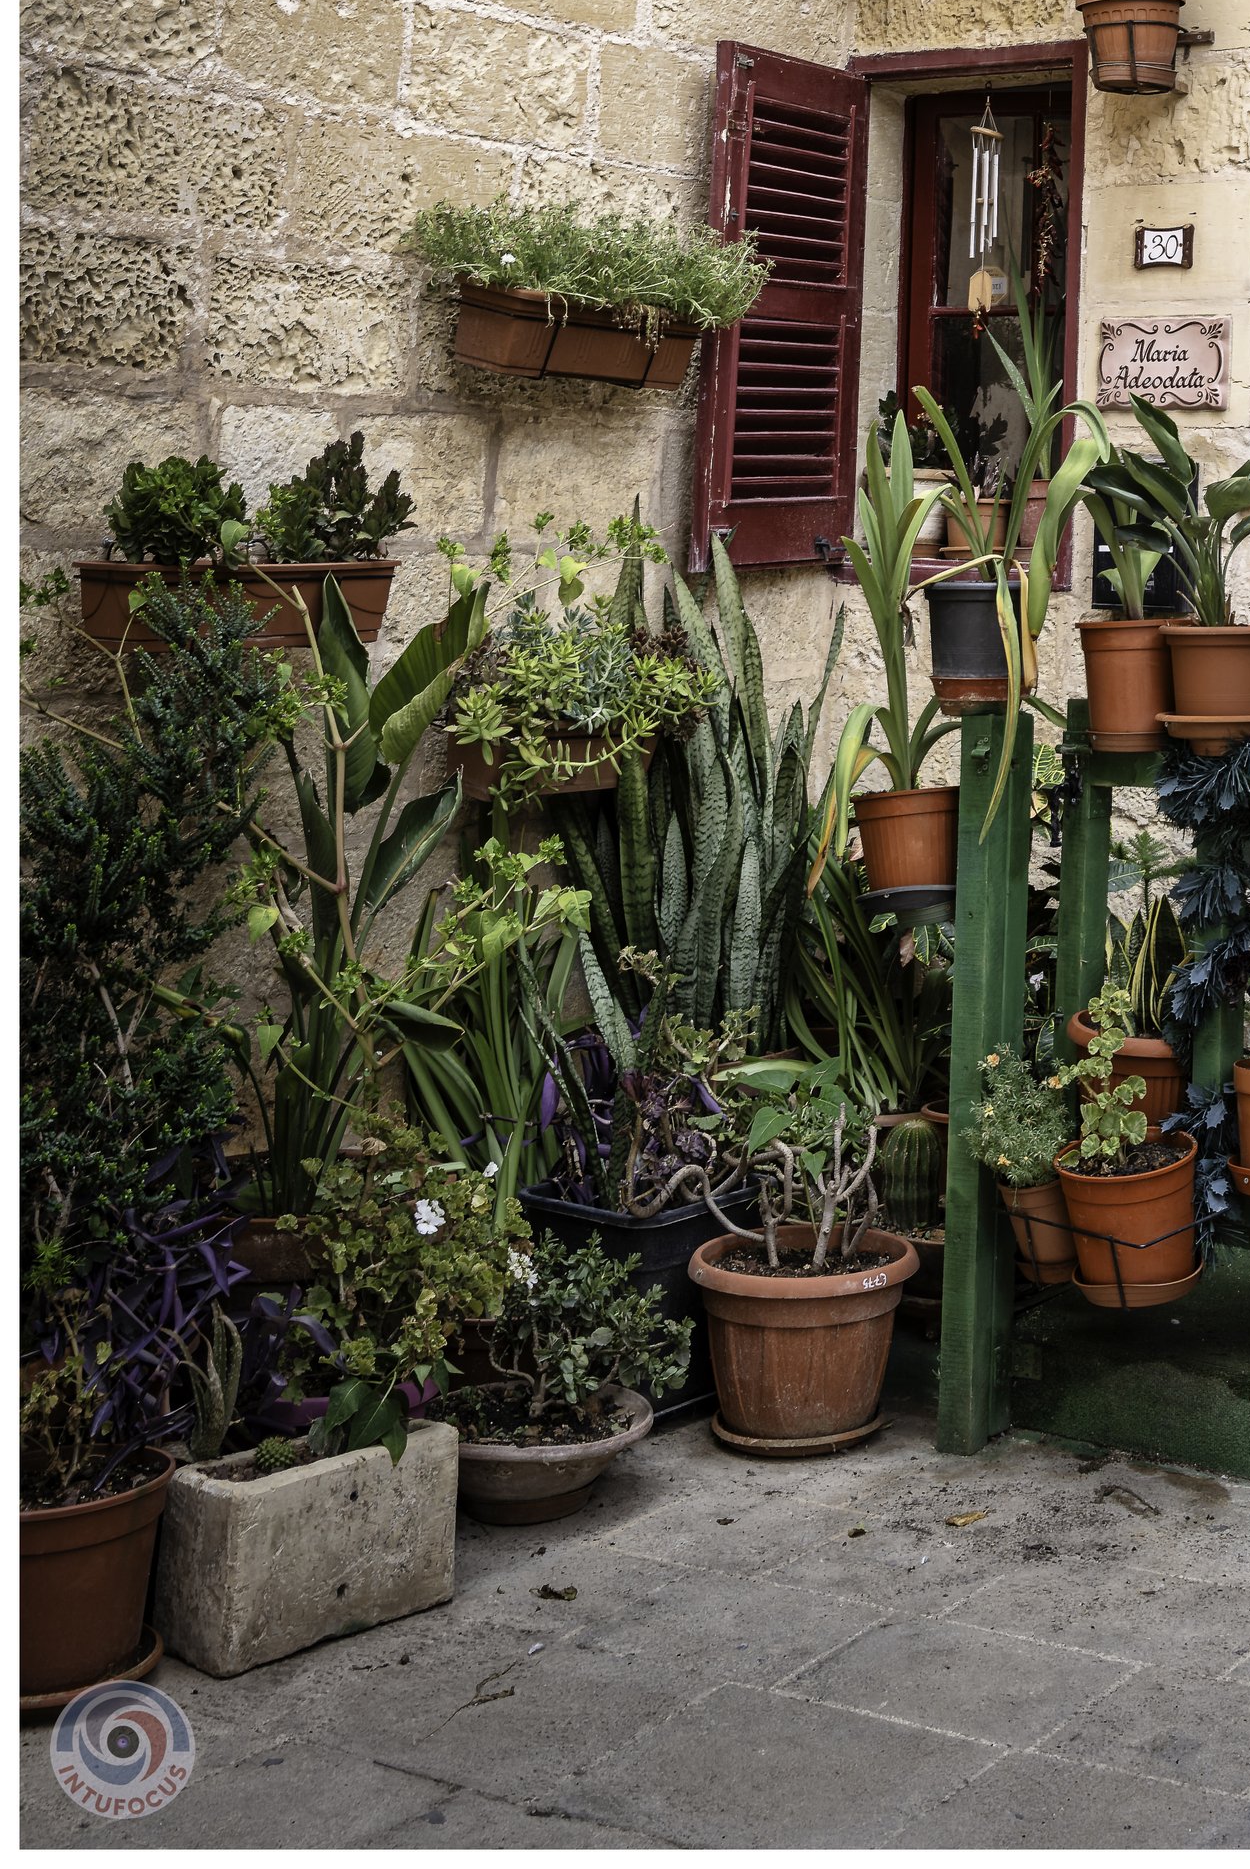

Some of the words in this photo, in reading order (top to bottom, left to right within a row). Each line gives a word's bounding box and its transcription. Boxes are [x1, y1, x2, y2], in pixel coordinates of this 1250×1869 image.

[1148, 235, 1179, 261] 30
[1130, 338, 1190, 363] Maria
[1112, 365, 1206, 390] Adeodata
